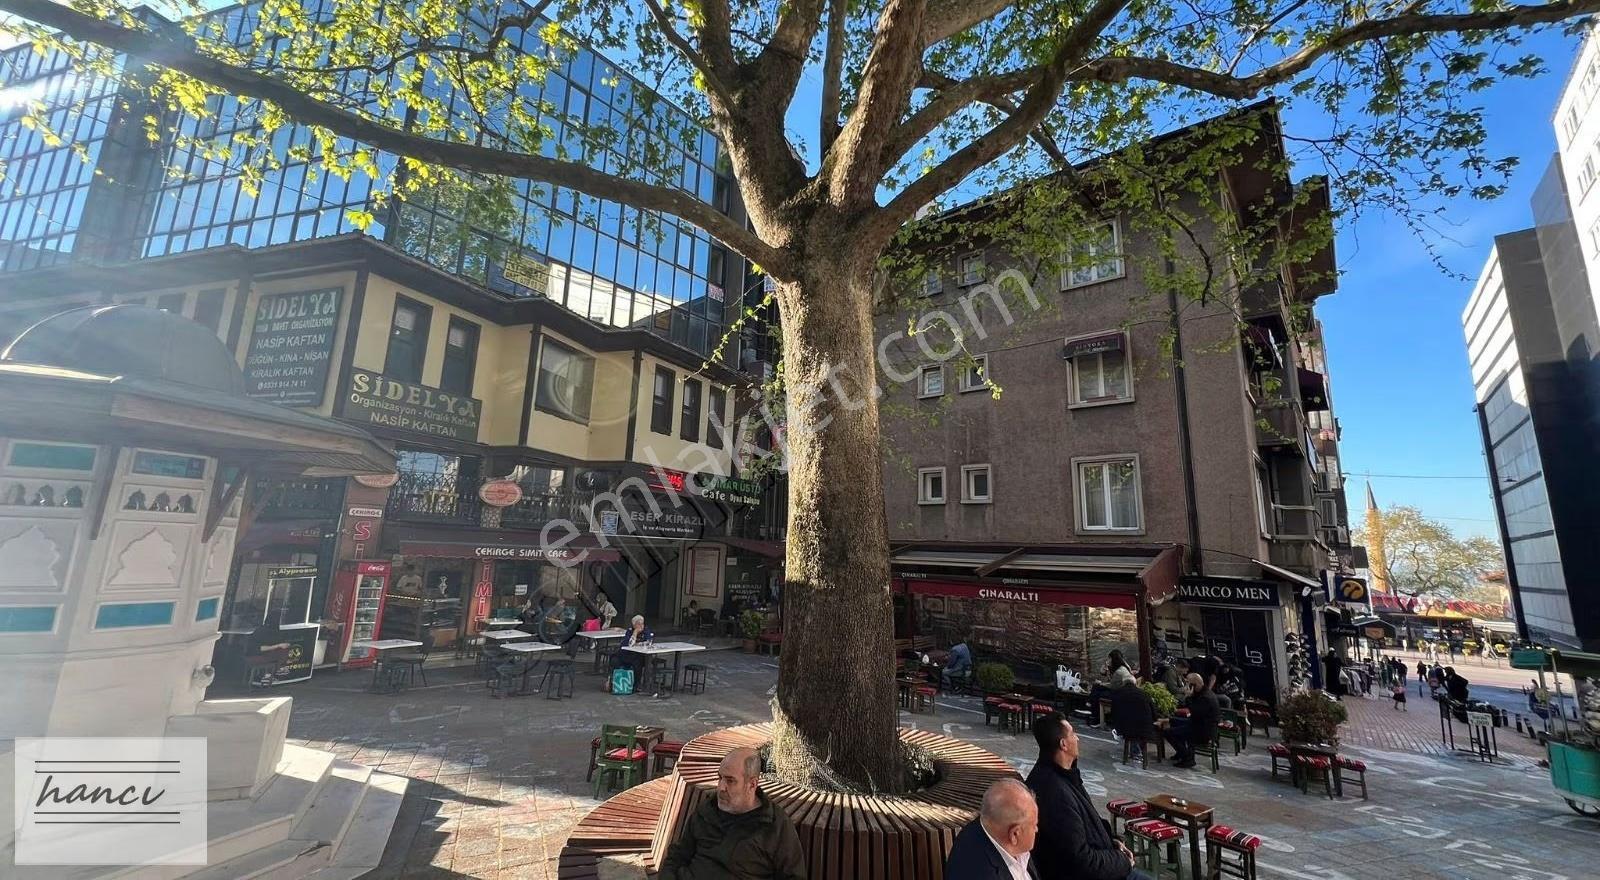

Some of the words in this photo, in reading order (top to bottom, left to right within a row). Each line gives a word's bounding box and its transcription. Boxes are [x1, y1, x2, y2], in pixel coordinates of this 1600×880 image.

[286, 334, 327, 347] KAFTAN
[283, 366, 315, 377] KAFTAN
[353, 373, 477, 418] SİDELYA
[351, 393, 416, 417] Organizasyon
[371, 411, 410, 428] NASİP
[412, 420, 458, 438] KAFTAN
[701, 489, 726, 501] Cafe
[631, 511, 661, 523] ESER
[548, 549, 568, 559] CAFE
[979, 589, 1039, 603] ÇINARALTI
[1179, 585, 1232, 599] MARCO
[1236, 587, 1271, 601] MEN
